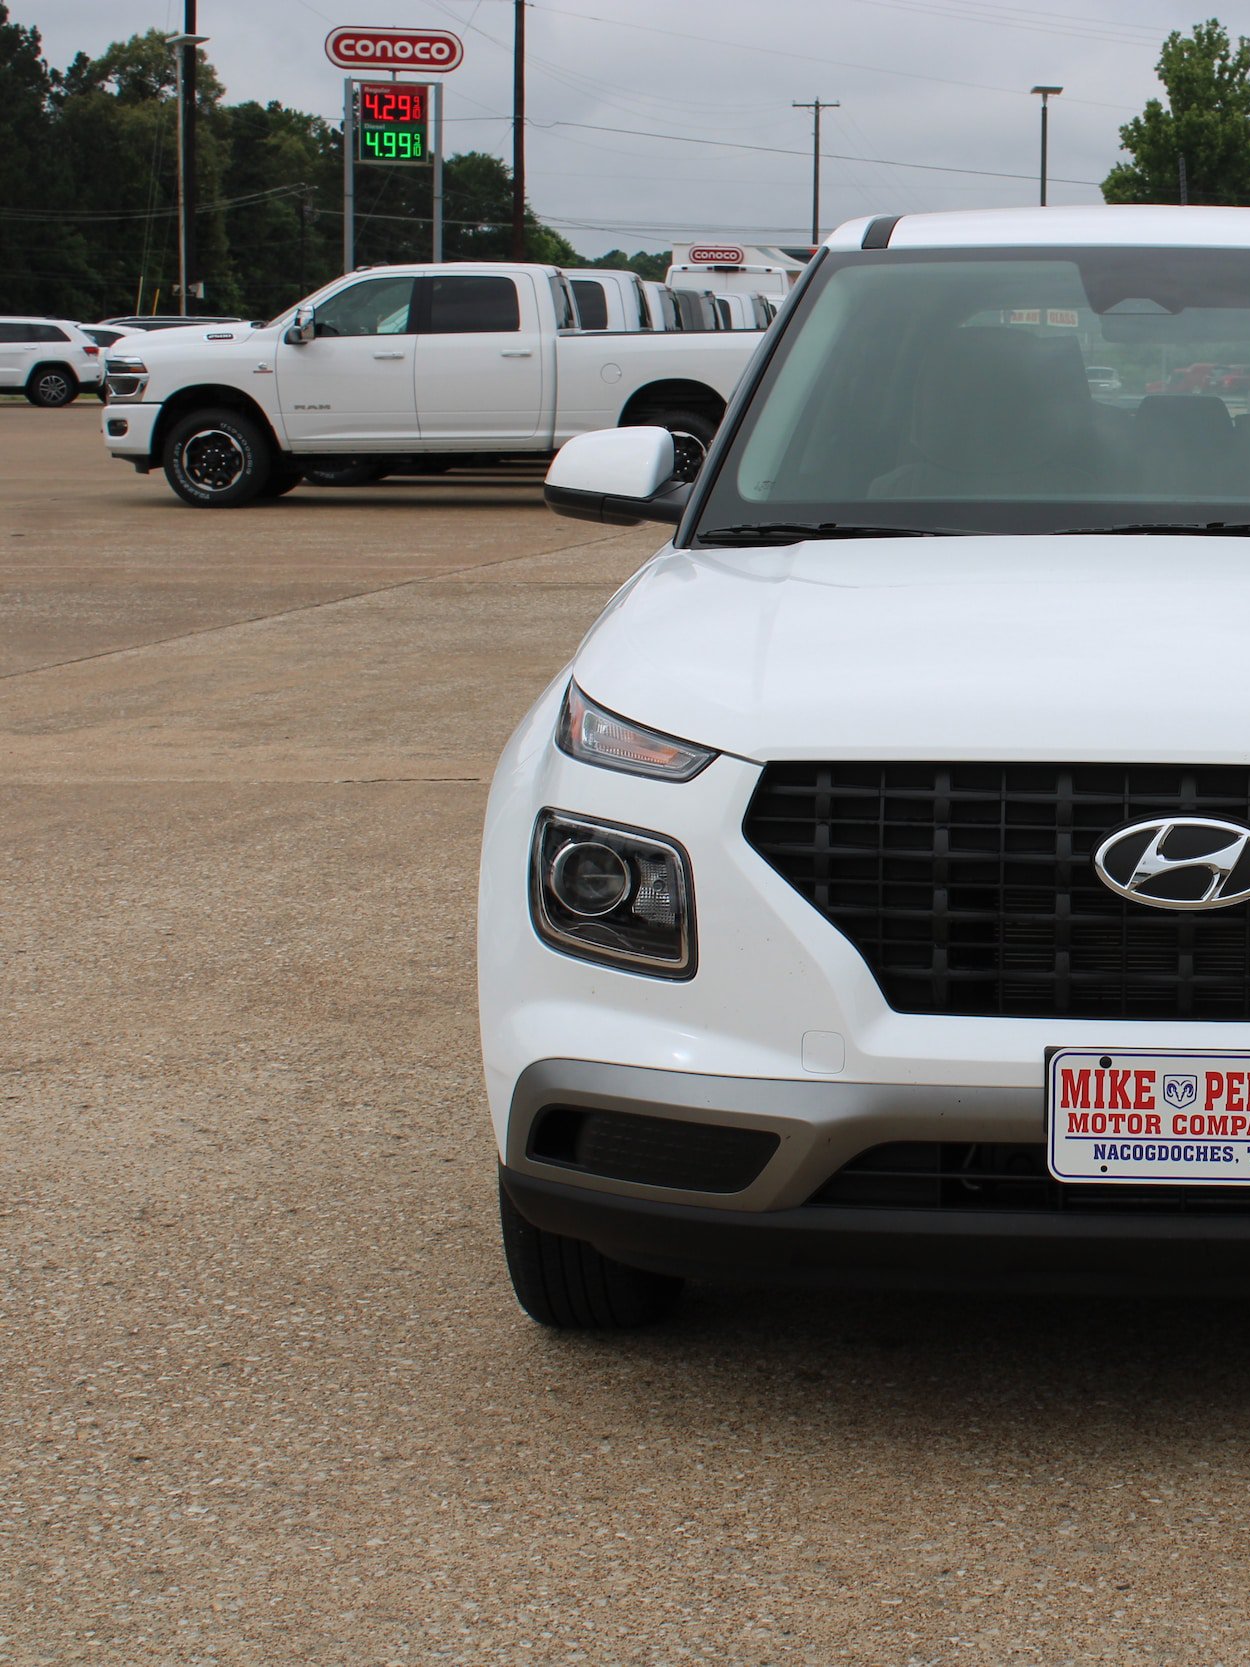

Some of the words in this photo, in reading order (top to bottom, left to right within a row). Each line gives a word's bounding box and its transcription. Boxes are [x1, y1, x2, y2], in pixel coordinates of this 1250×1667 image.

[1060, 1068, 1156, 1110] MIKE
[1067, 1112, 1162, 1135] MOTOR
[1093, 1144, 1240, 1164] NACOGDOCHES,
